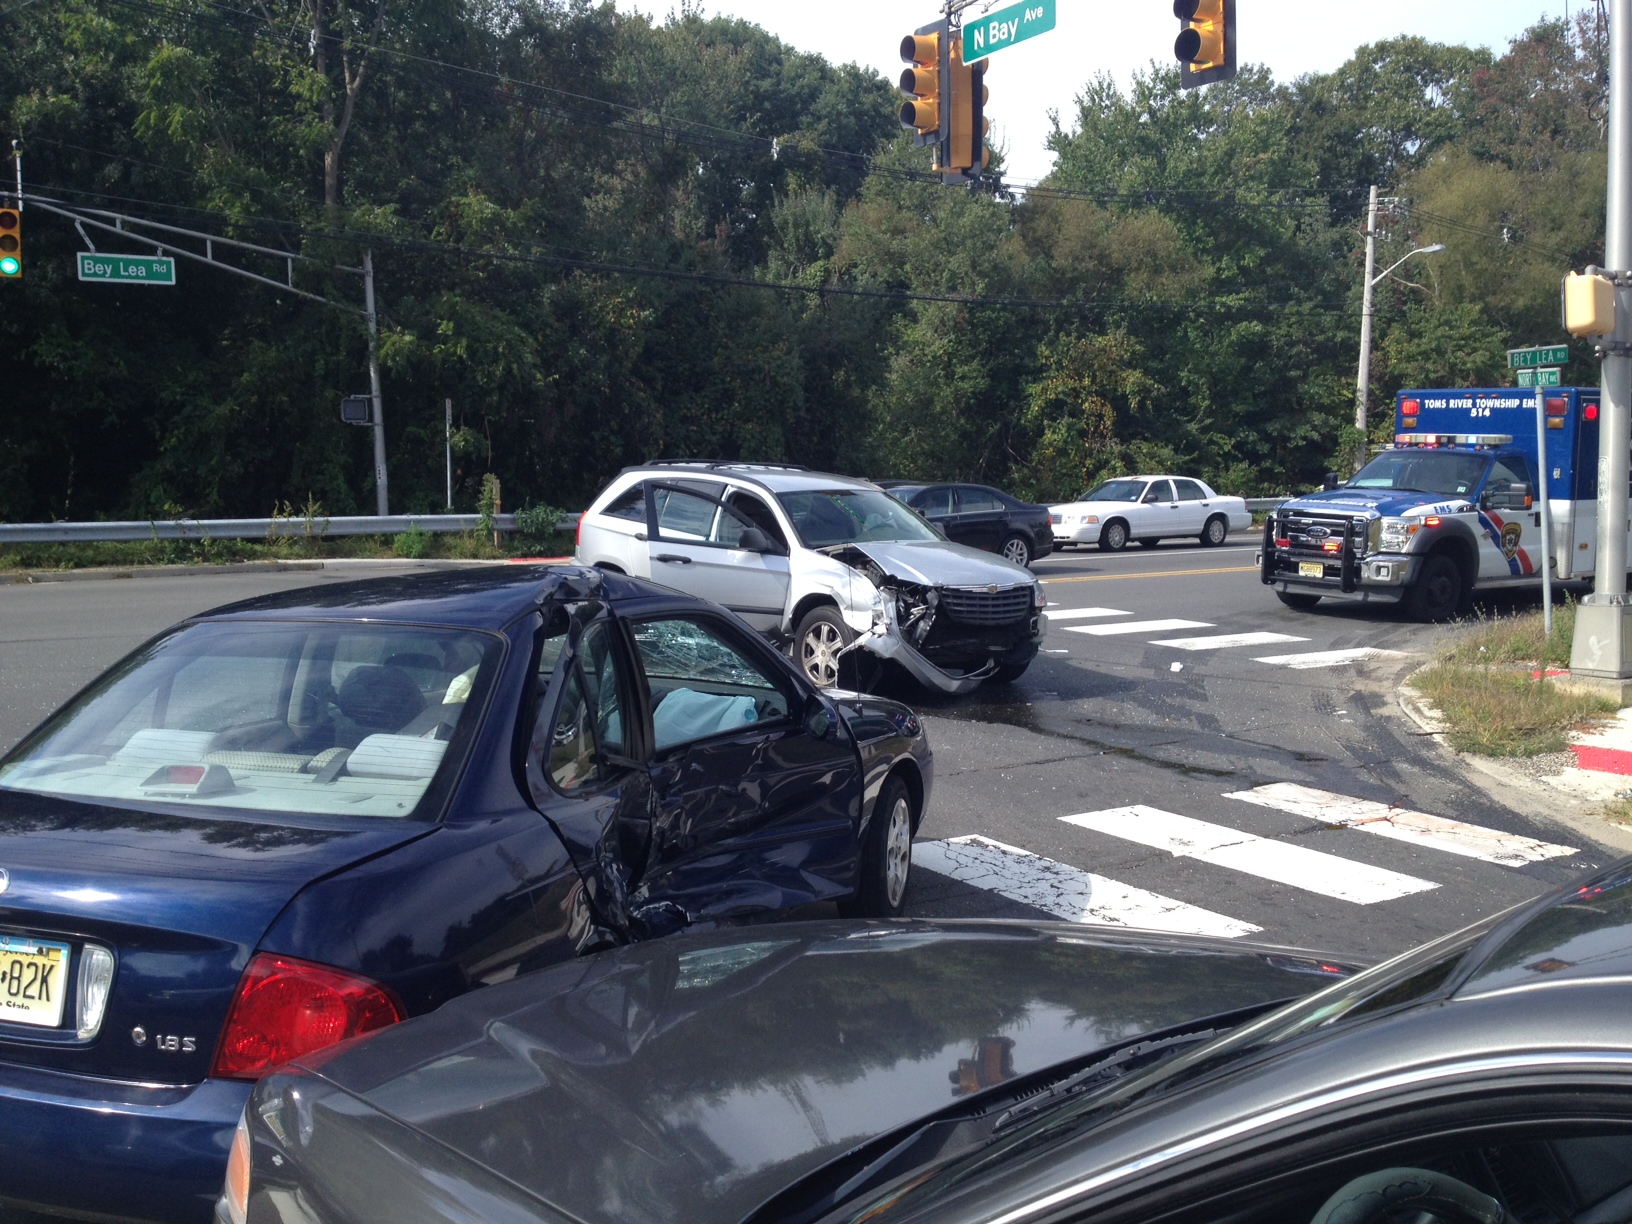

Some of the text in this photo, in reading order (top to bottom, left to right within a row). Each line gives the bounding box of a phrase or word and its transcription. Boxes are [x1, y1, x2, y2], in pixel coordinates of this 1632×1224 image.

[973, 5, 1044, 51] N Bay Ave
[84, 259, 167, 278] Bey Lea Rd
[1513, 349, 1566, 367] BEY LEA RD
[1518, 373, 1536, 386] NORTH
[1537, 372, 1549, 385] BAY
[1424, 399, 1447, 409] TOMS
[1449, 399, 1473, 409] RIVER
[1475, 399, 1520, 409] TOWNSHIP
[1470, 407, 1491, 418] 514
[1433, 504, 1452, 514] EMS
